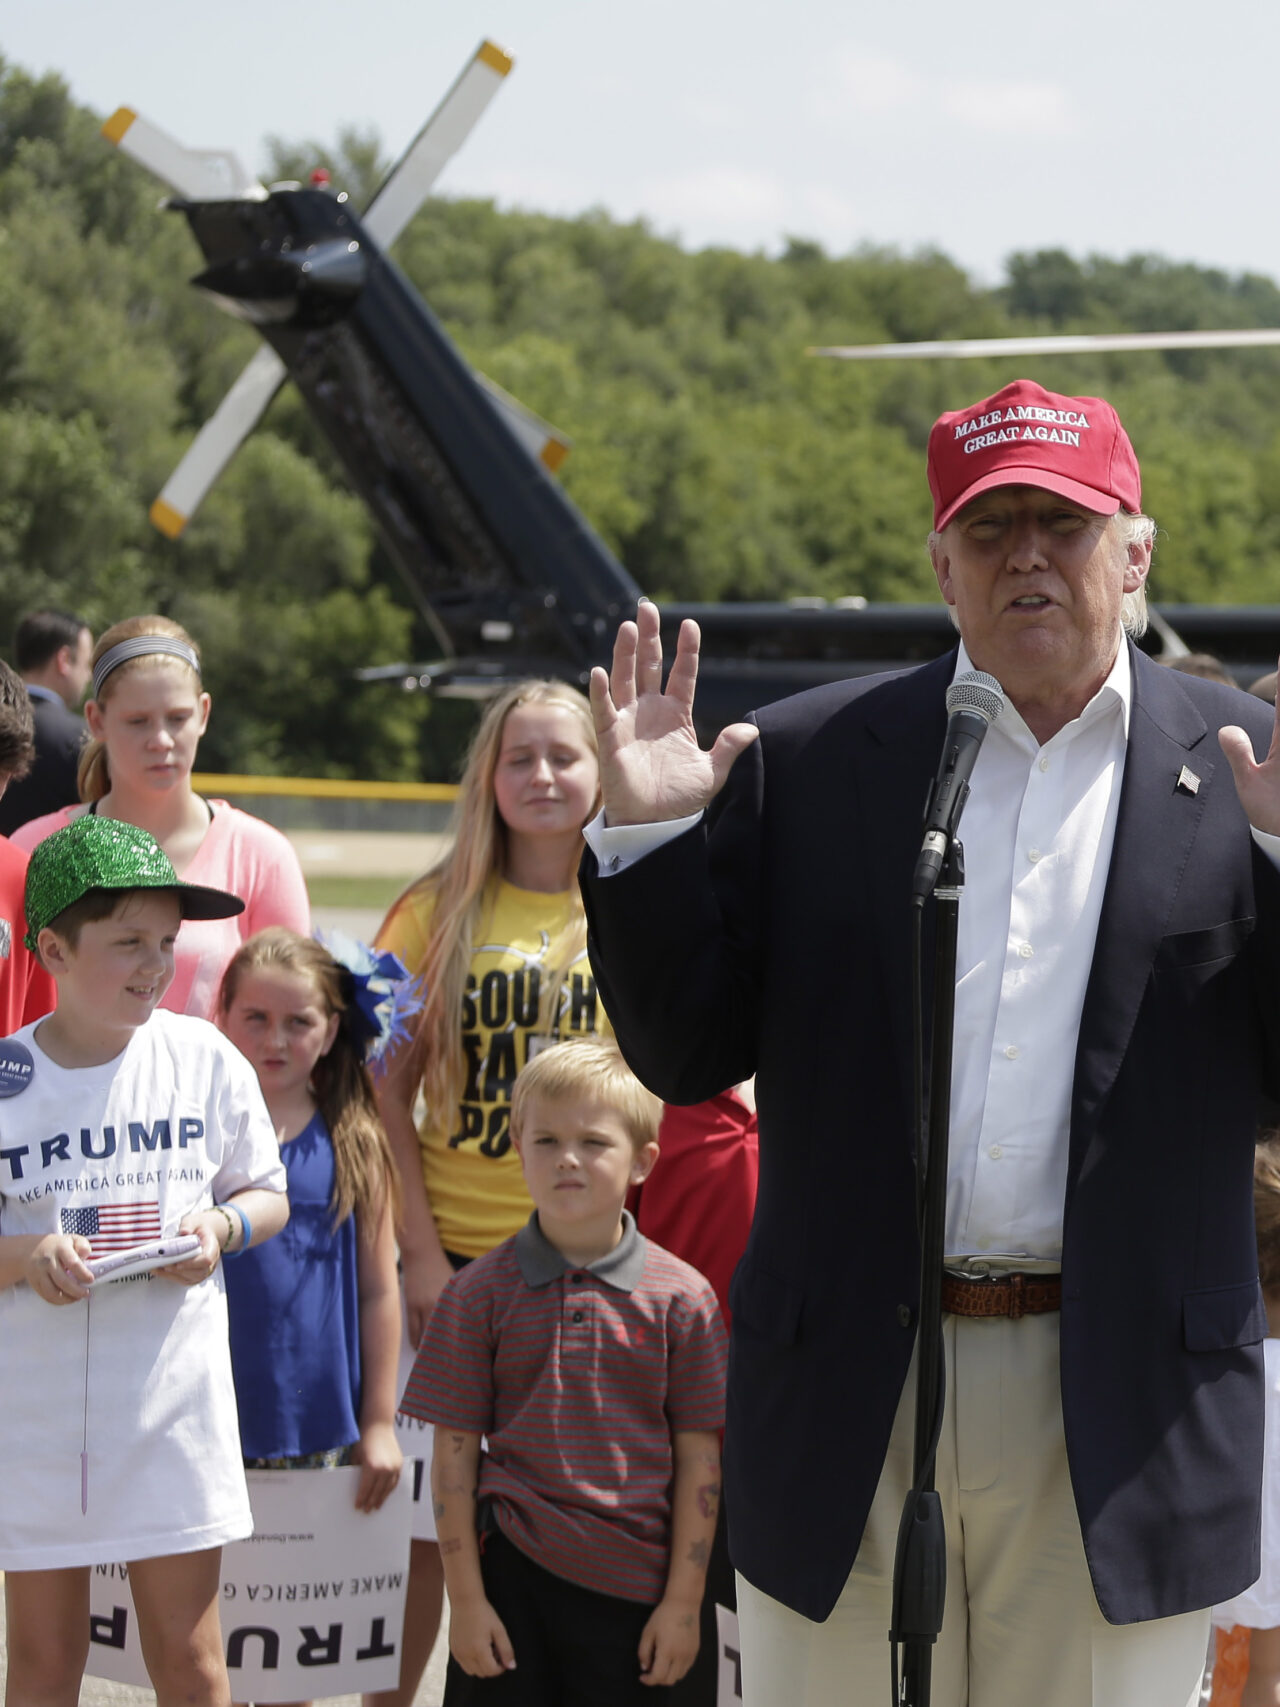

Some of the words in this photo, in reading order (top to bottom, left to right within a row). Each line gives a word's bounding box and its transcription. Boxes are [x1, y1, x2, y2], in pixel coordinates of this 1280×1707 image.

[953, 410, 1002, 440] MAKE
[1003, 406, 1090, 428] AMERICA
[963, 426, 1020, 454] GREAT
[1021, 426, 1080, 448] AGAIN
[0, 1060, 31, 1073] UMP
[0, 1117, 205, 1180] TRUMP
[18, 1186, 42, 1205] AKE
[44, 1177, 110, 1196] AMERICA
[115, 1169, 163, 1187] GREAT
[96, 1562, 129, 1581] AIN
[350, 1572, 403, 1595] MAKE
[247, 1580, 344, 1601] AMERICA
